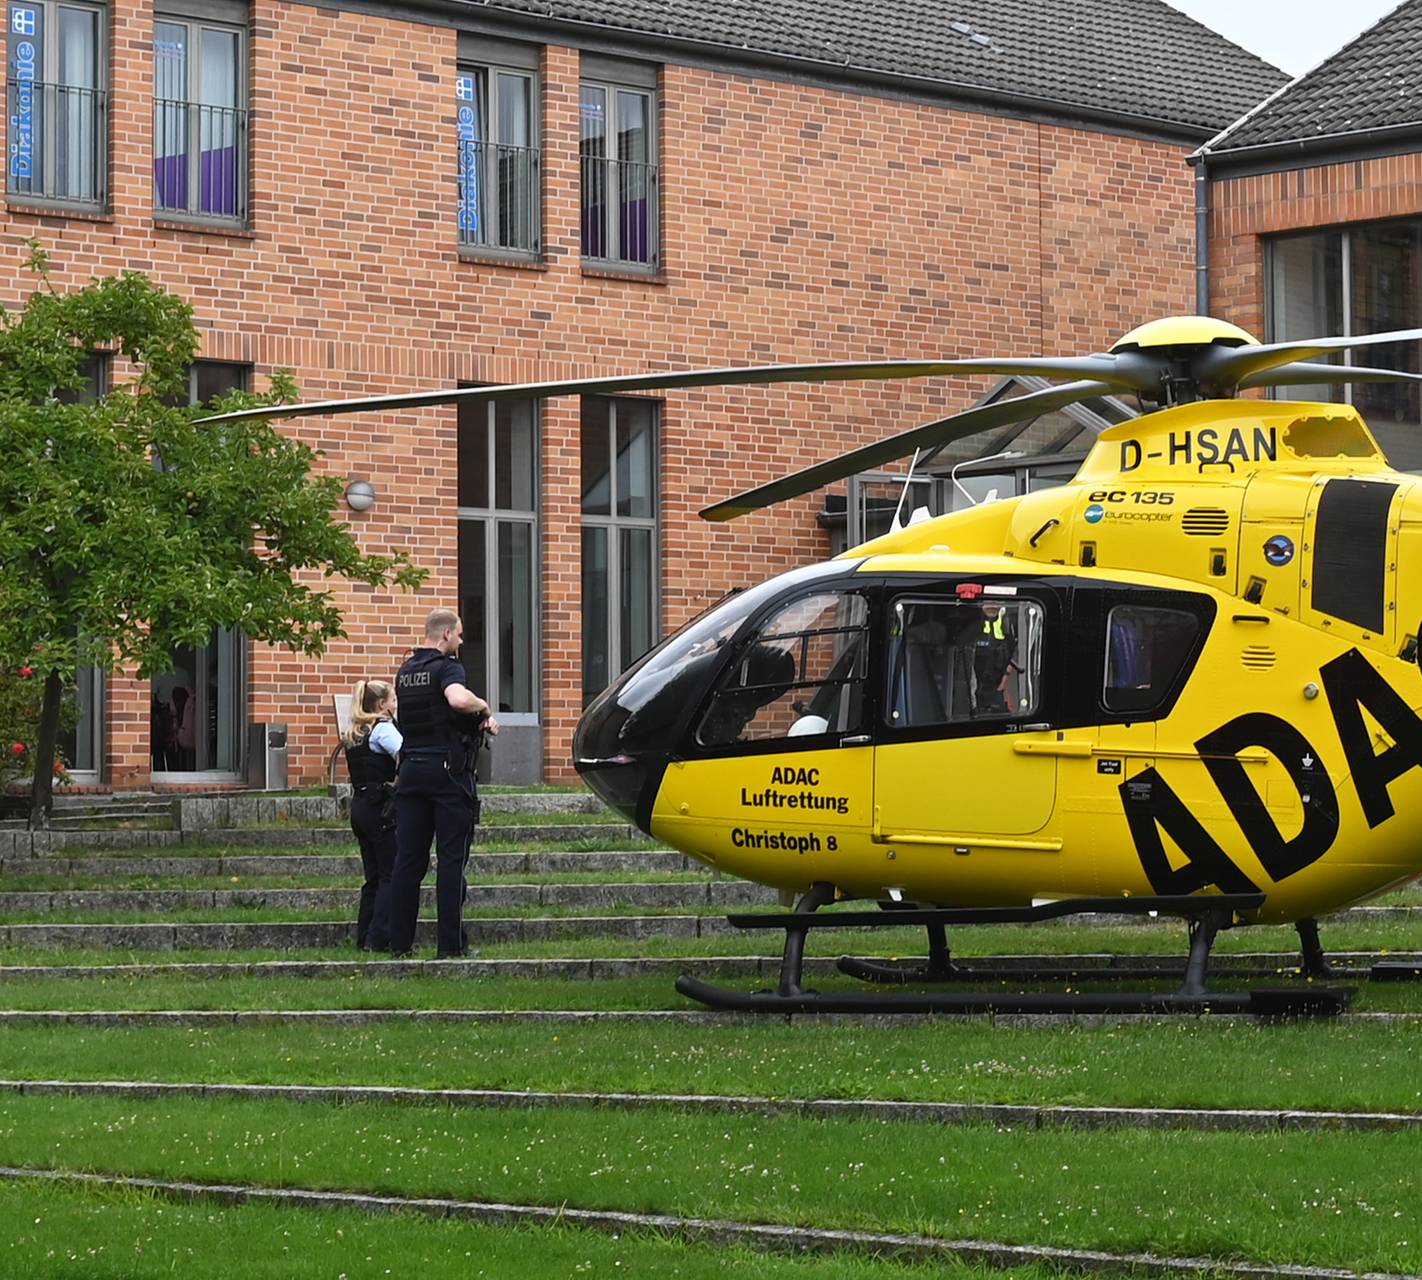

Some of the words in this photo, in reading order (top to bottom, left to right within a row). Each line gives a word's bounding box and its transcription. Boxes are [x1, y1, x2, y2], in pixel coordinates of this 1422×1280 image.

[10, 41, 36, 177] Diakonie
[458, 106, 478, 231] Diakonie
[1120, 427, 1277, 472] D-HSAN
[1130, 491, 1175, 505] 135
[1104, 511, 1174, 522] eurocopter
[399, 671, 431, 687] POLIZEI
[771, 767, 820, 786] ADAC
[741, 787, 849, 814] Luftrettung
[731, 828, 821, 854] Christoph
[827, 835, 838, 851] 8
